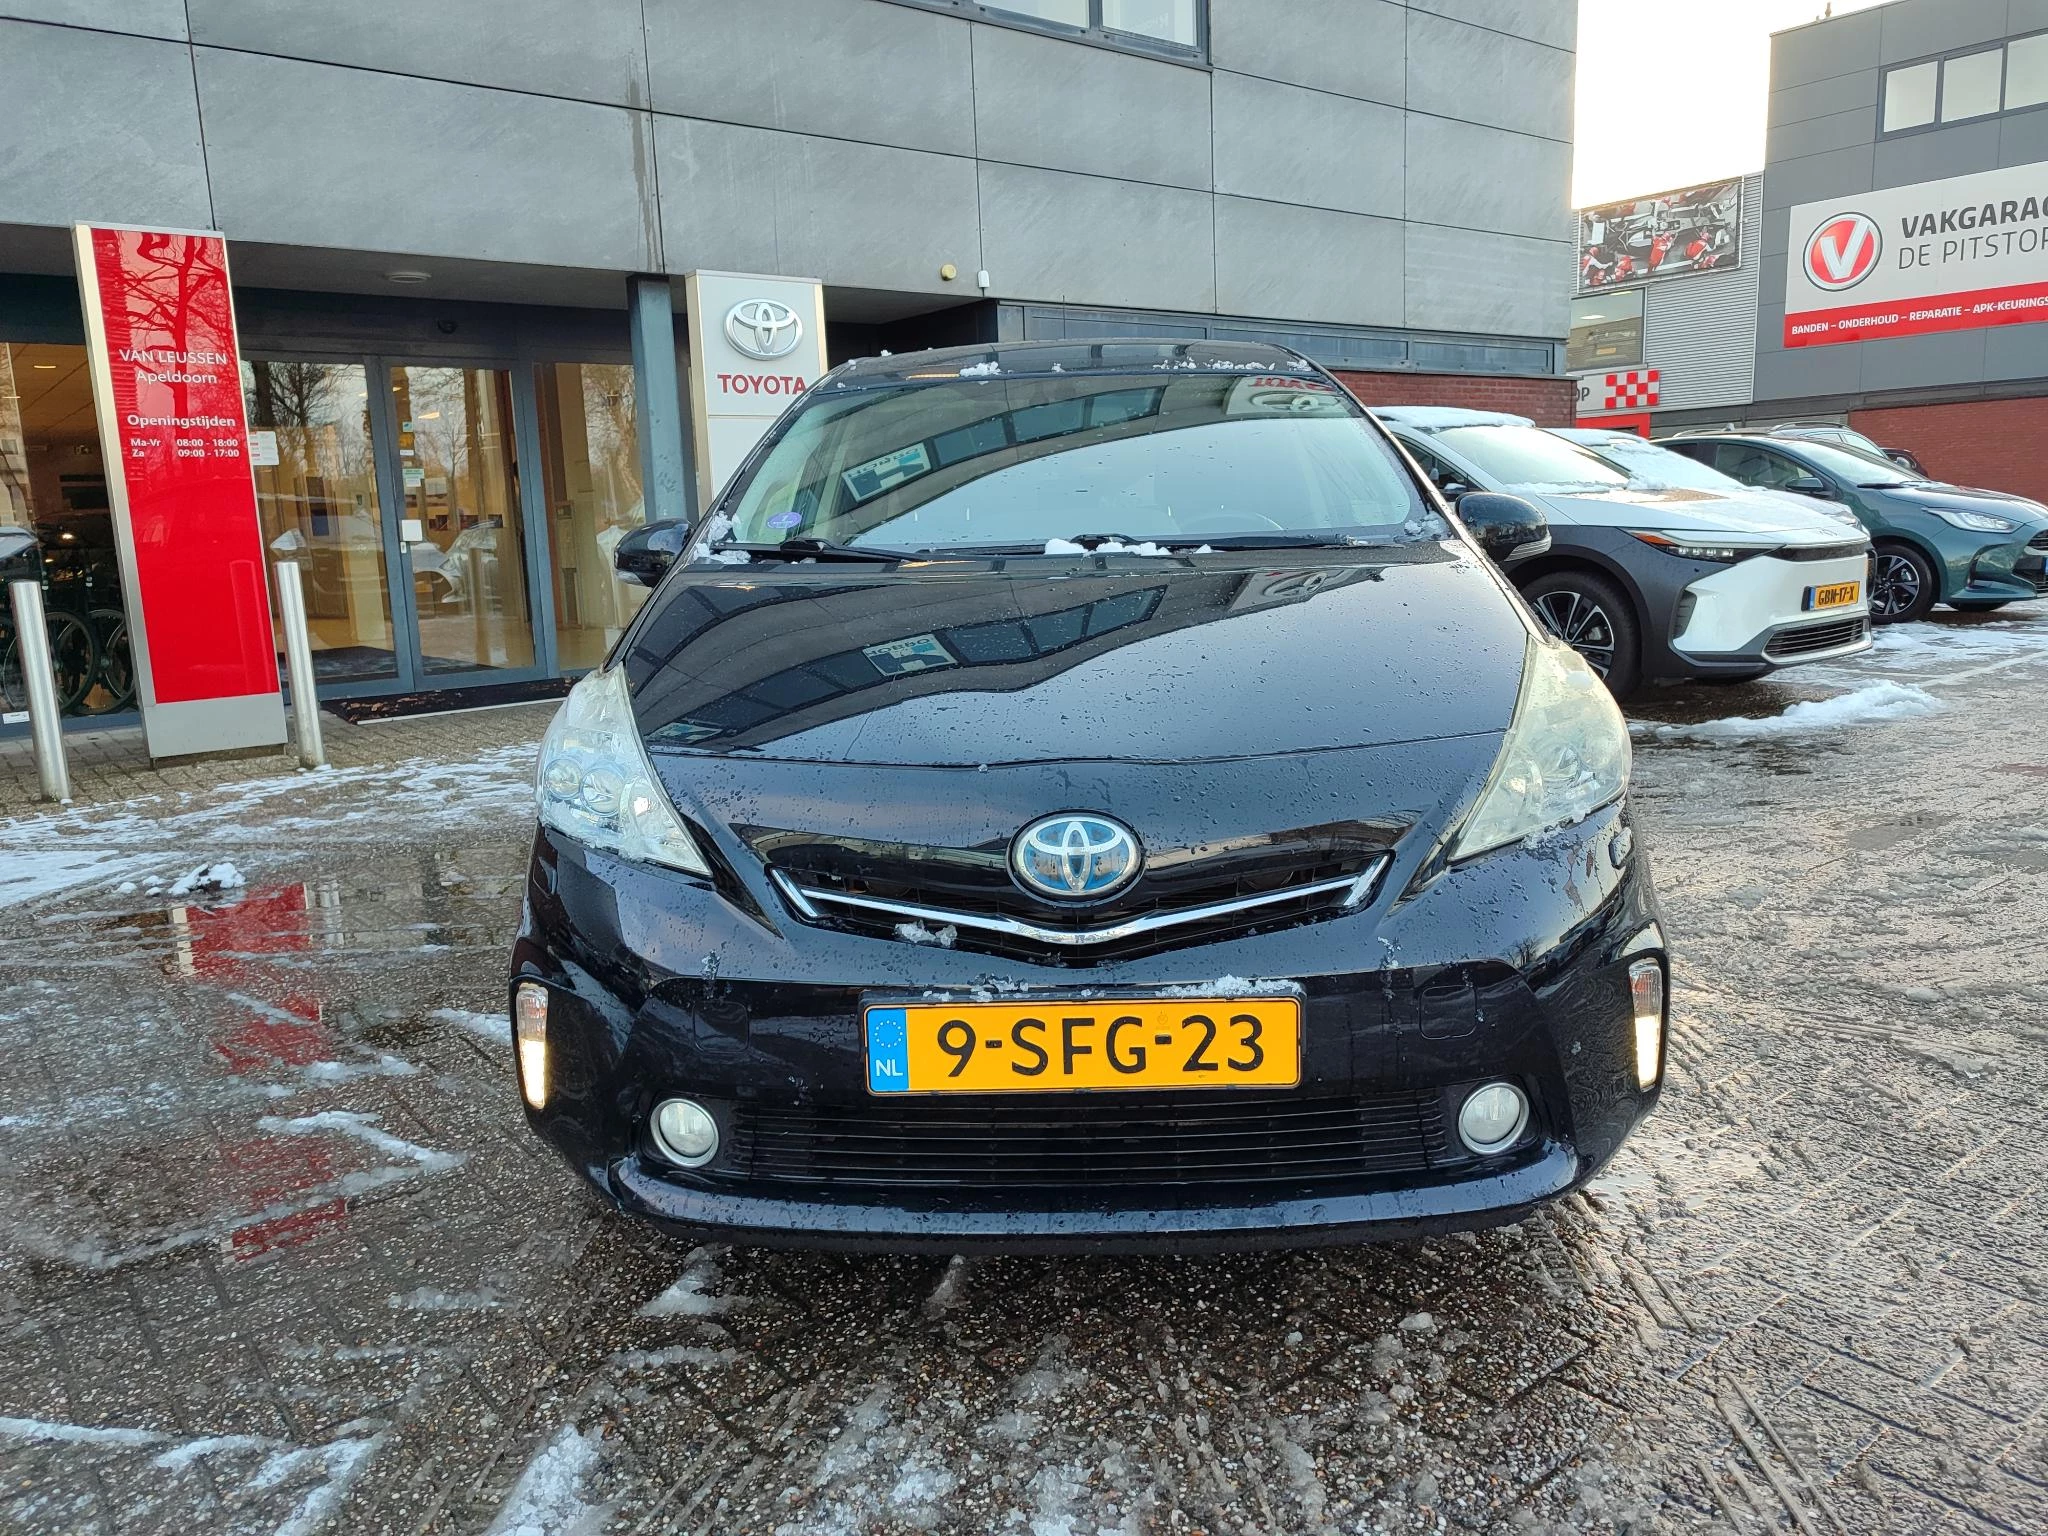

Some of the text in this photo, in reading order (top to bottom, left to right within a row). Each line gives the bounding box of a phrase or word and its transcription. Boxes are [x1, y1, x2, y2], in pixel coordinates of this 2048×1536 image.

[1899, 244, 1931, 269] DE
[1791, 323, 1829, 335] BANDEN
[1838, 314, 1899, 330] ONDERHOUD
[1909, 306, 1962, 321] REPARATIE
[119, 349, 228, 364] VAN LEUSSEN
[136, 370, 217, 384] Apeldoorn
[717, 374, 807, 395] TOYOTA
[127, 414, 236, 429] Openingstijden
[130, 438, 161, 447] Ma-Vr
[176, 438, 204, 447] 08:00
[212, 438, 239, 447] 18:00
[132, 449, 145, 458] Za
[178, 449, 205, 458] 09:00
[213, 449, 240, 458] 17:00
[937, 1014, 1265, 1078] 9-SFG-23
[875, 1059, 904, 1077] NL
